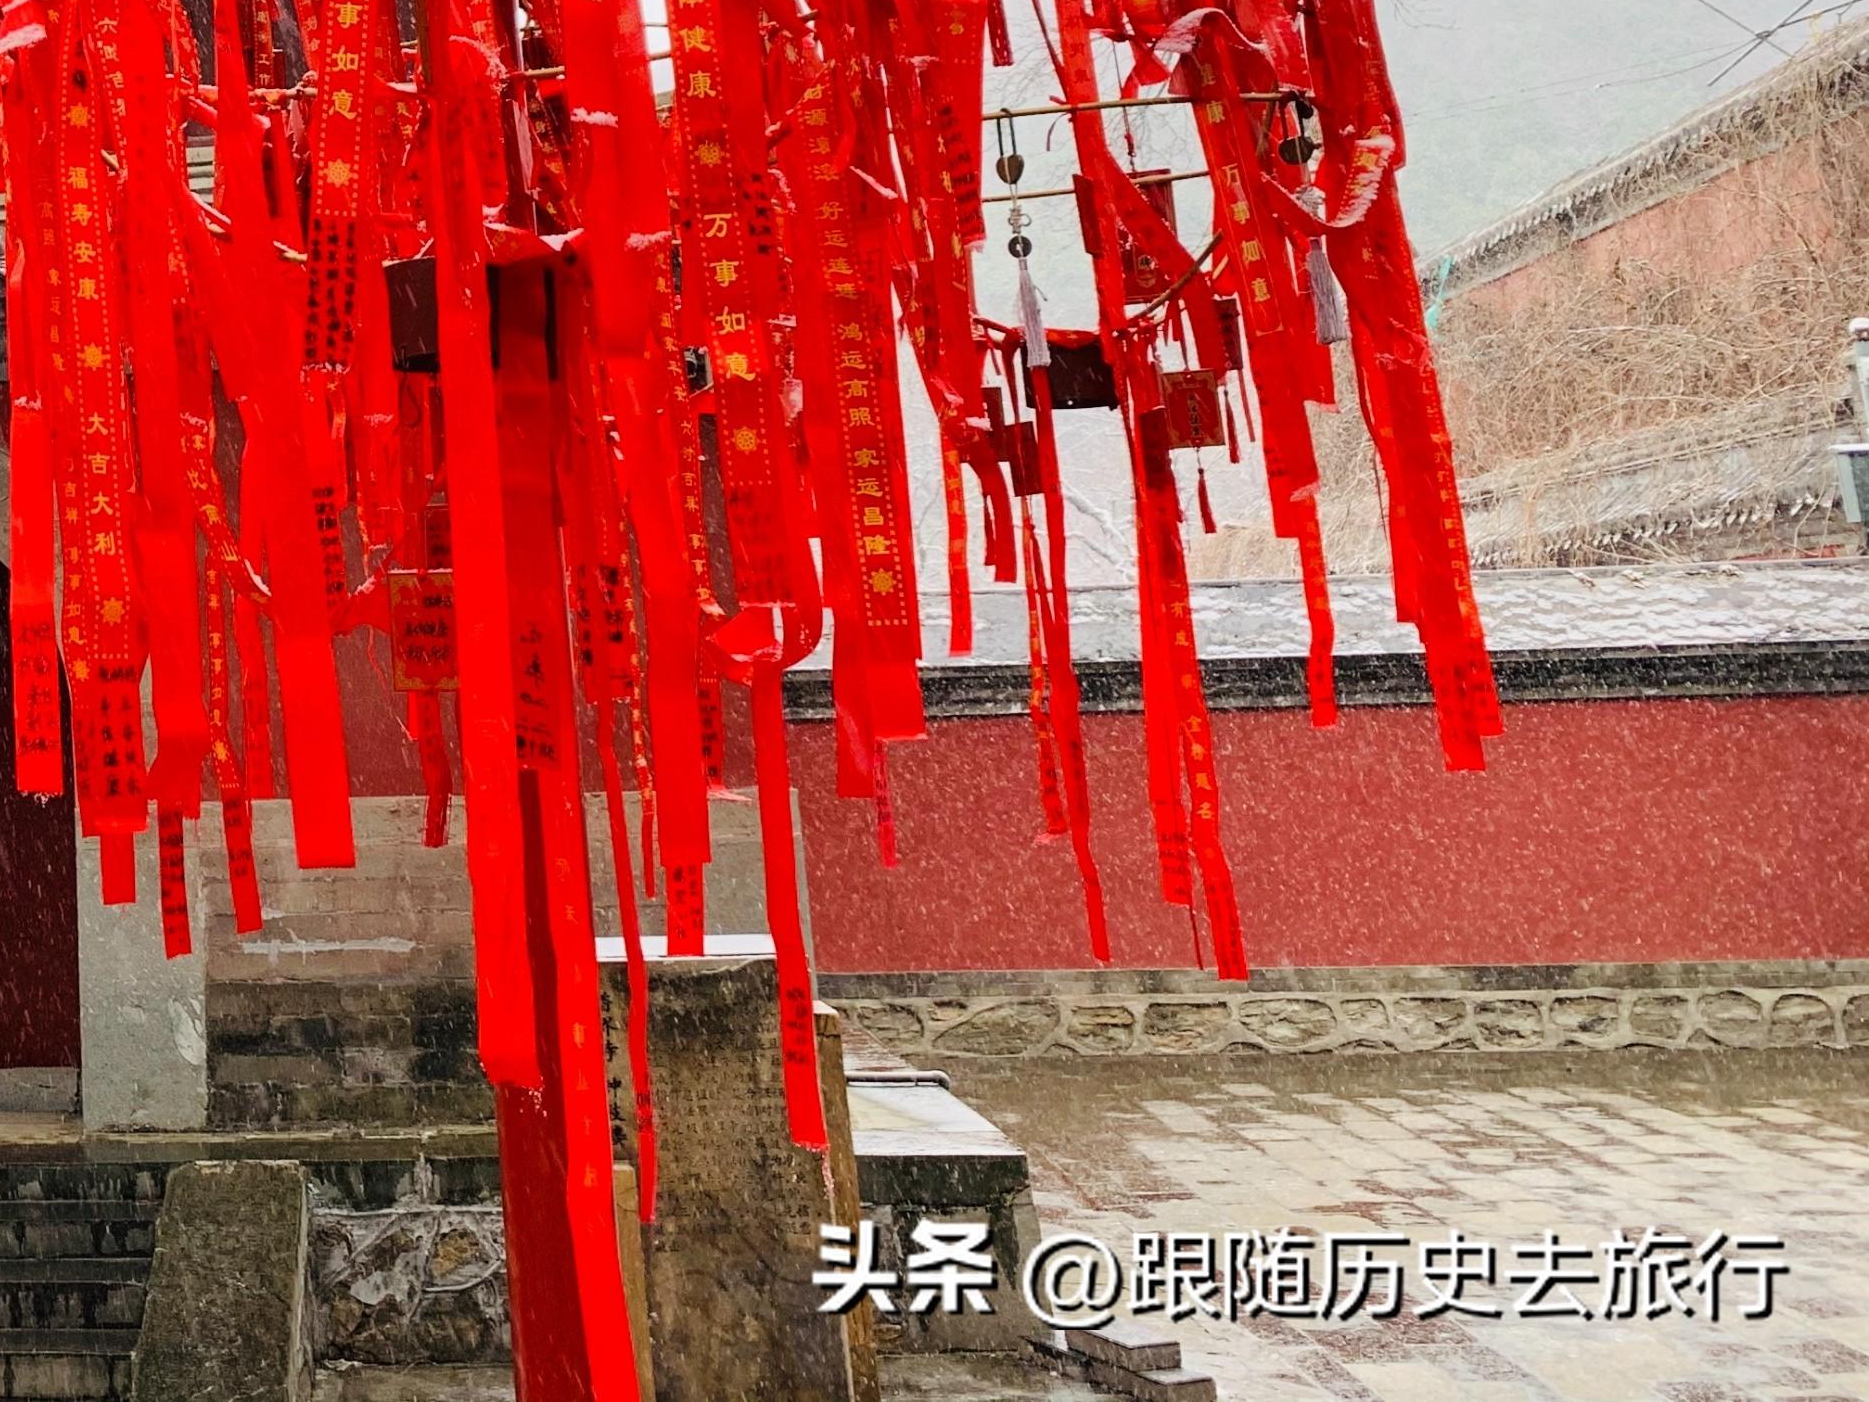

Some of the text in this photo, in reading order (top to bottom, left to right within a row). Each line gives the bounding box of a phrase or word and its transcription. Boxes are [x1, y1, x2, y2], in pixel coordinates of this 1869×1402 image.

[818, 201, 857, 300] 好运连连
[1222, 163, 1269, 302] 万事如意
[705, 212, 757, 383] 万事如意
[68, 166, 117, 556] 福寿安康 大吉大利
[837, 323, 874, 427] 鸿运高照
[852, 447, 890, 555] 家运昌隆
